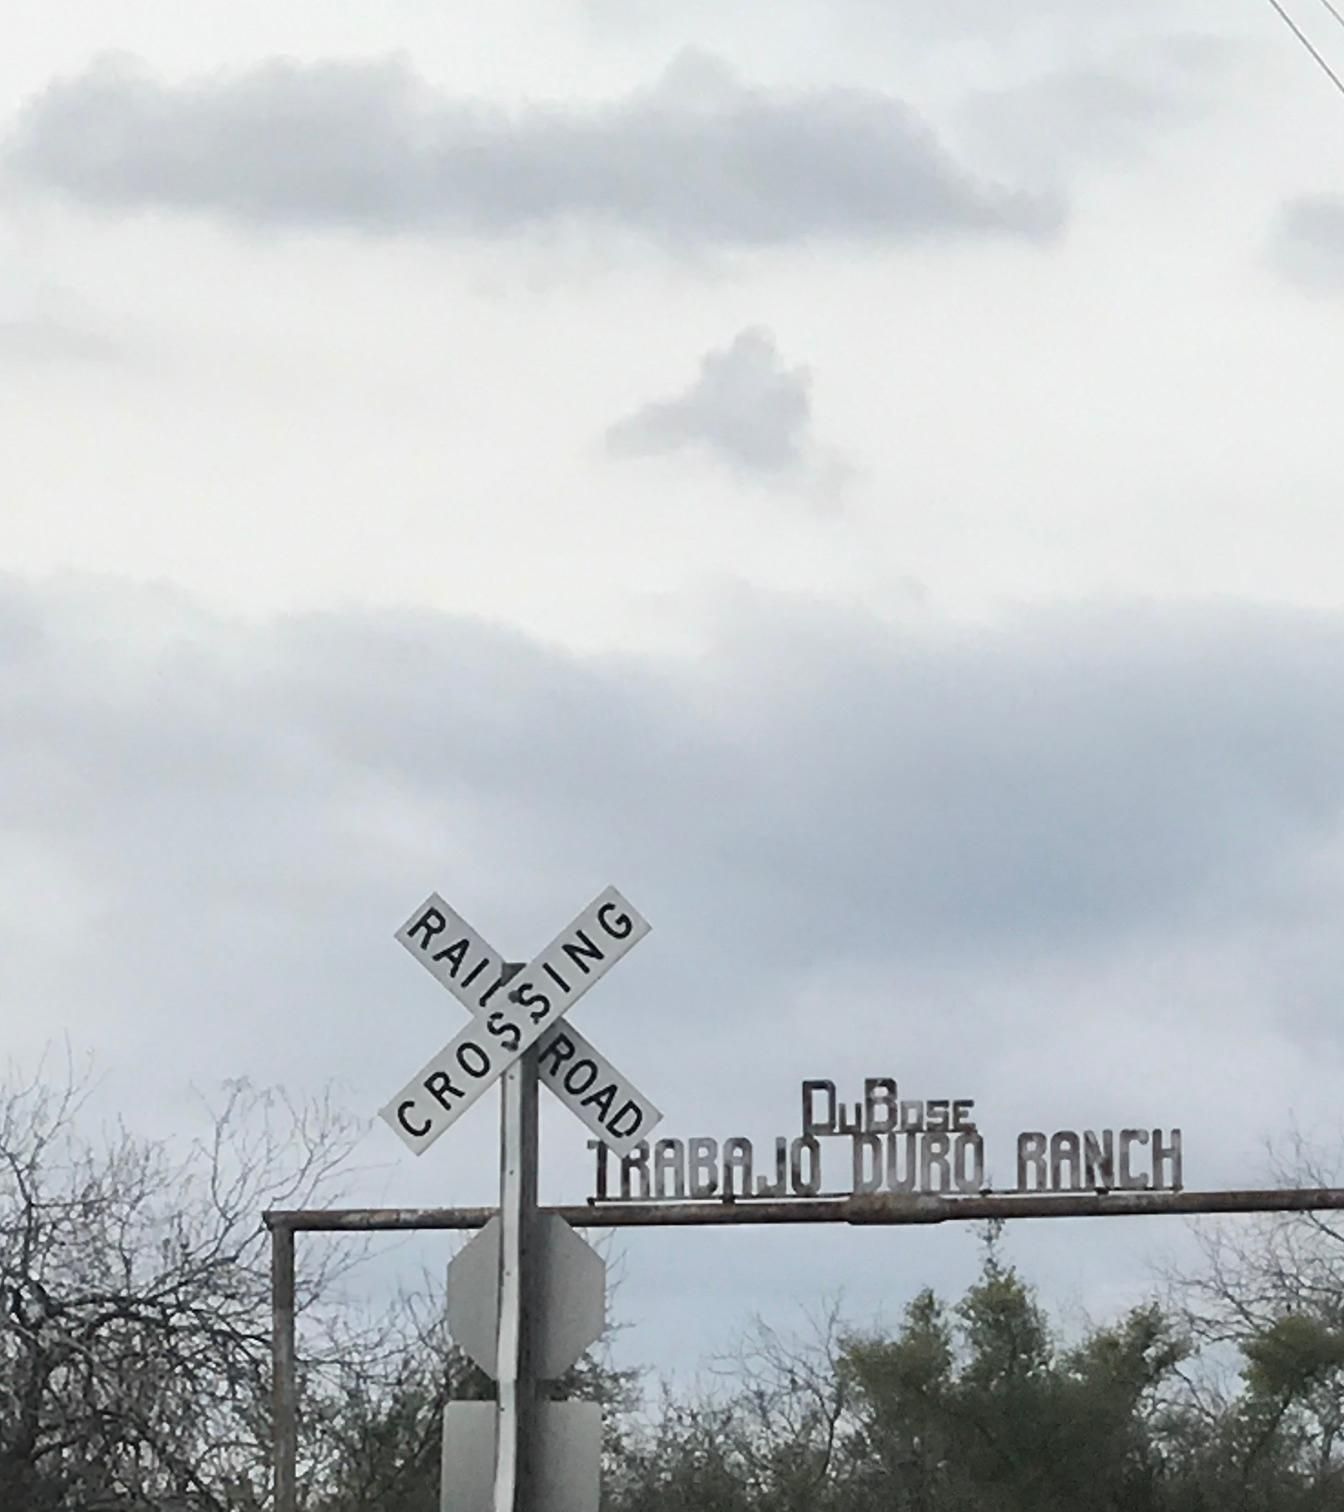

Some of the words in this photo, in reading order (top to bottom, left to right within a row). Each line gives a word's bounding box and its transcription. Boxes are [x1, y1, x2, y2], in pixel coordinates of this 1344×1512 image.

[397, 902, 634, 1137] CROSSING
[538, 1032, 643, 1138] ROAD
[587, 1136, 822, 1197] TRABAJO
[852, 1131, 984, 1196] DURO
[1017, 1127, 1183, 1193] RANCH
